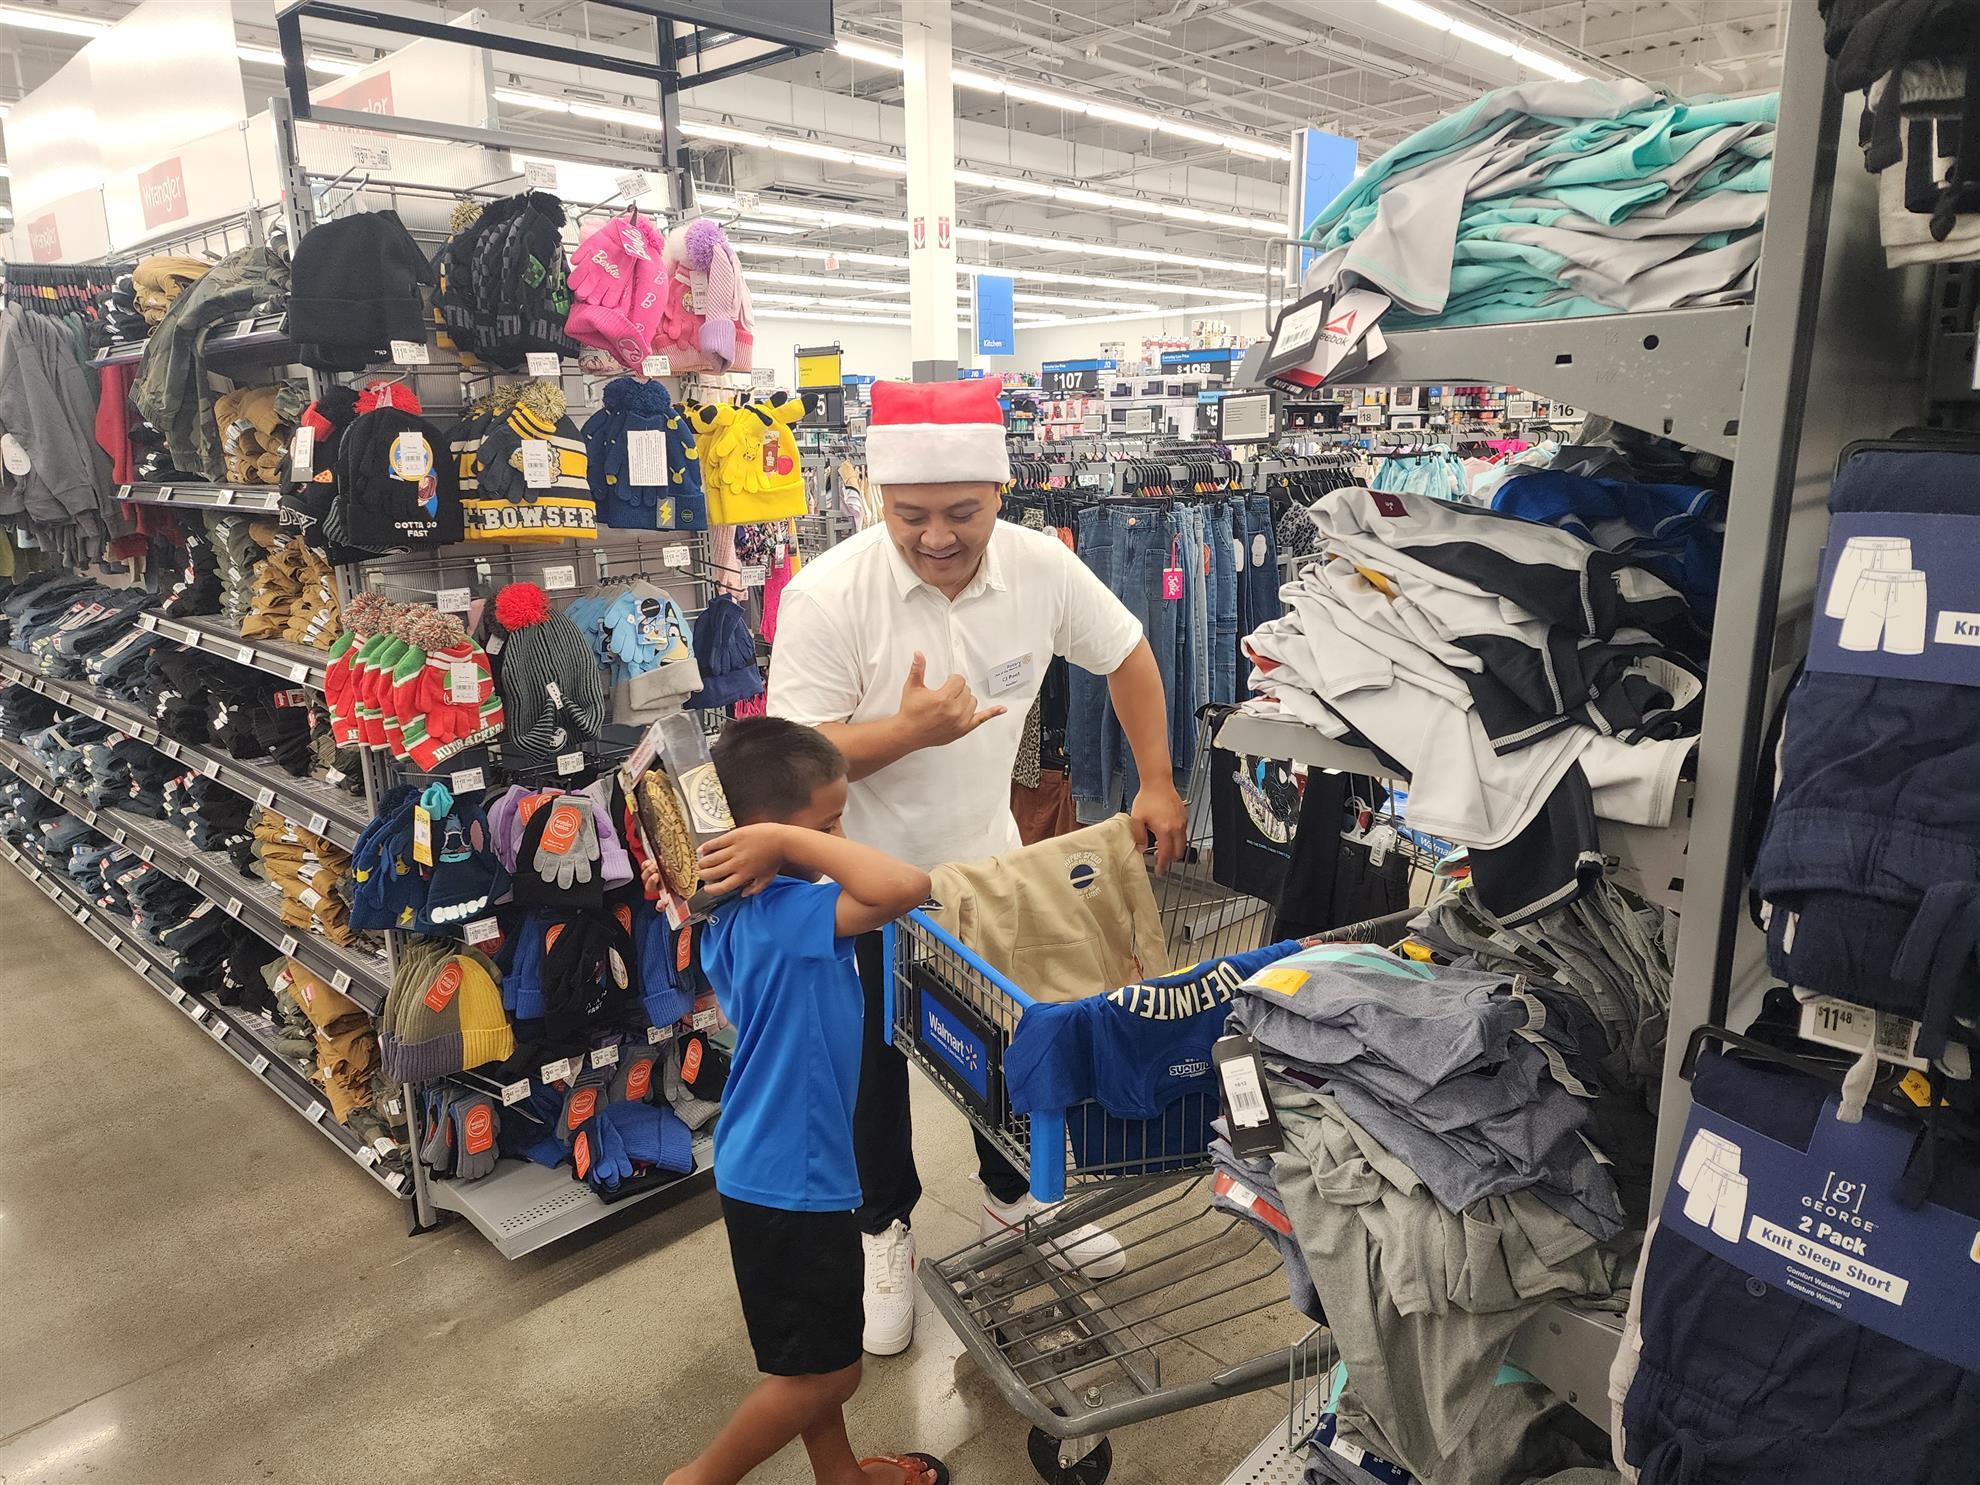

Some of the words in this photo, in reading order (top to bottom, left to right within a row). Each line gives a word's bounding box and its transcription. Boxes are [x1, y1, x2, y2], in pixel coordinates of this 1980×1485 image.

[142, 175, 181, 213] Wrangler
[31, 225, 57, 255] Wrangler
[591, 250, 621, 280] Barbie
[983, 339, 1003, 347] Kitchen
[1320, 332, 1346, 347] eebok
[1053, 371, 1083, 390] $107
[1553, 404, 1575, 418] $16
[394, 521, 424, 530] GOTTA
[481, 505, 597, 531] BOWSER
[407, 529, 429, 538] FAST
[1063, 852, 1082, 868] HYPER
[1083, 851, 1103, 865] SPEED
[1107, 960, 1245, 1021] DEFINITELY
[928, 1010, 965, 1058] Walmart
[1801, 1196, 1874, 1233] GEORGE
[1798, 1215, 1813, 1234] 2
[1816, 1222, 1868, 1257] Pack
[1761, 1226, 1793, 1251] Knit
[1796, 1243, 1842, 1273] Sleep
[1846, 1264, 1893, 1294] Short
[1786, 1265, 1814, 1282] Comfort
[1814, 1277, 1851, 1298] Waistband
[1786, 1279, 1815, 1297] Moisture
[1815, 1292, 1843, 1310] Wicking
